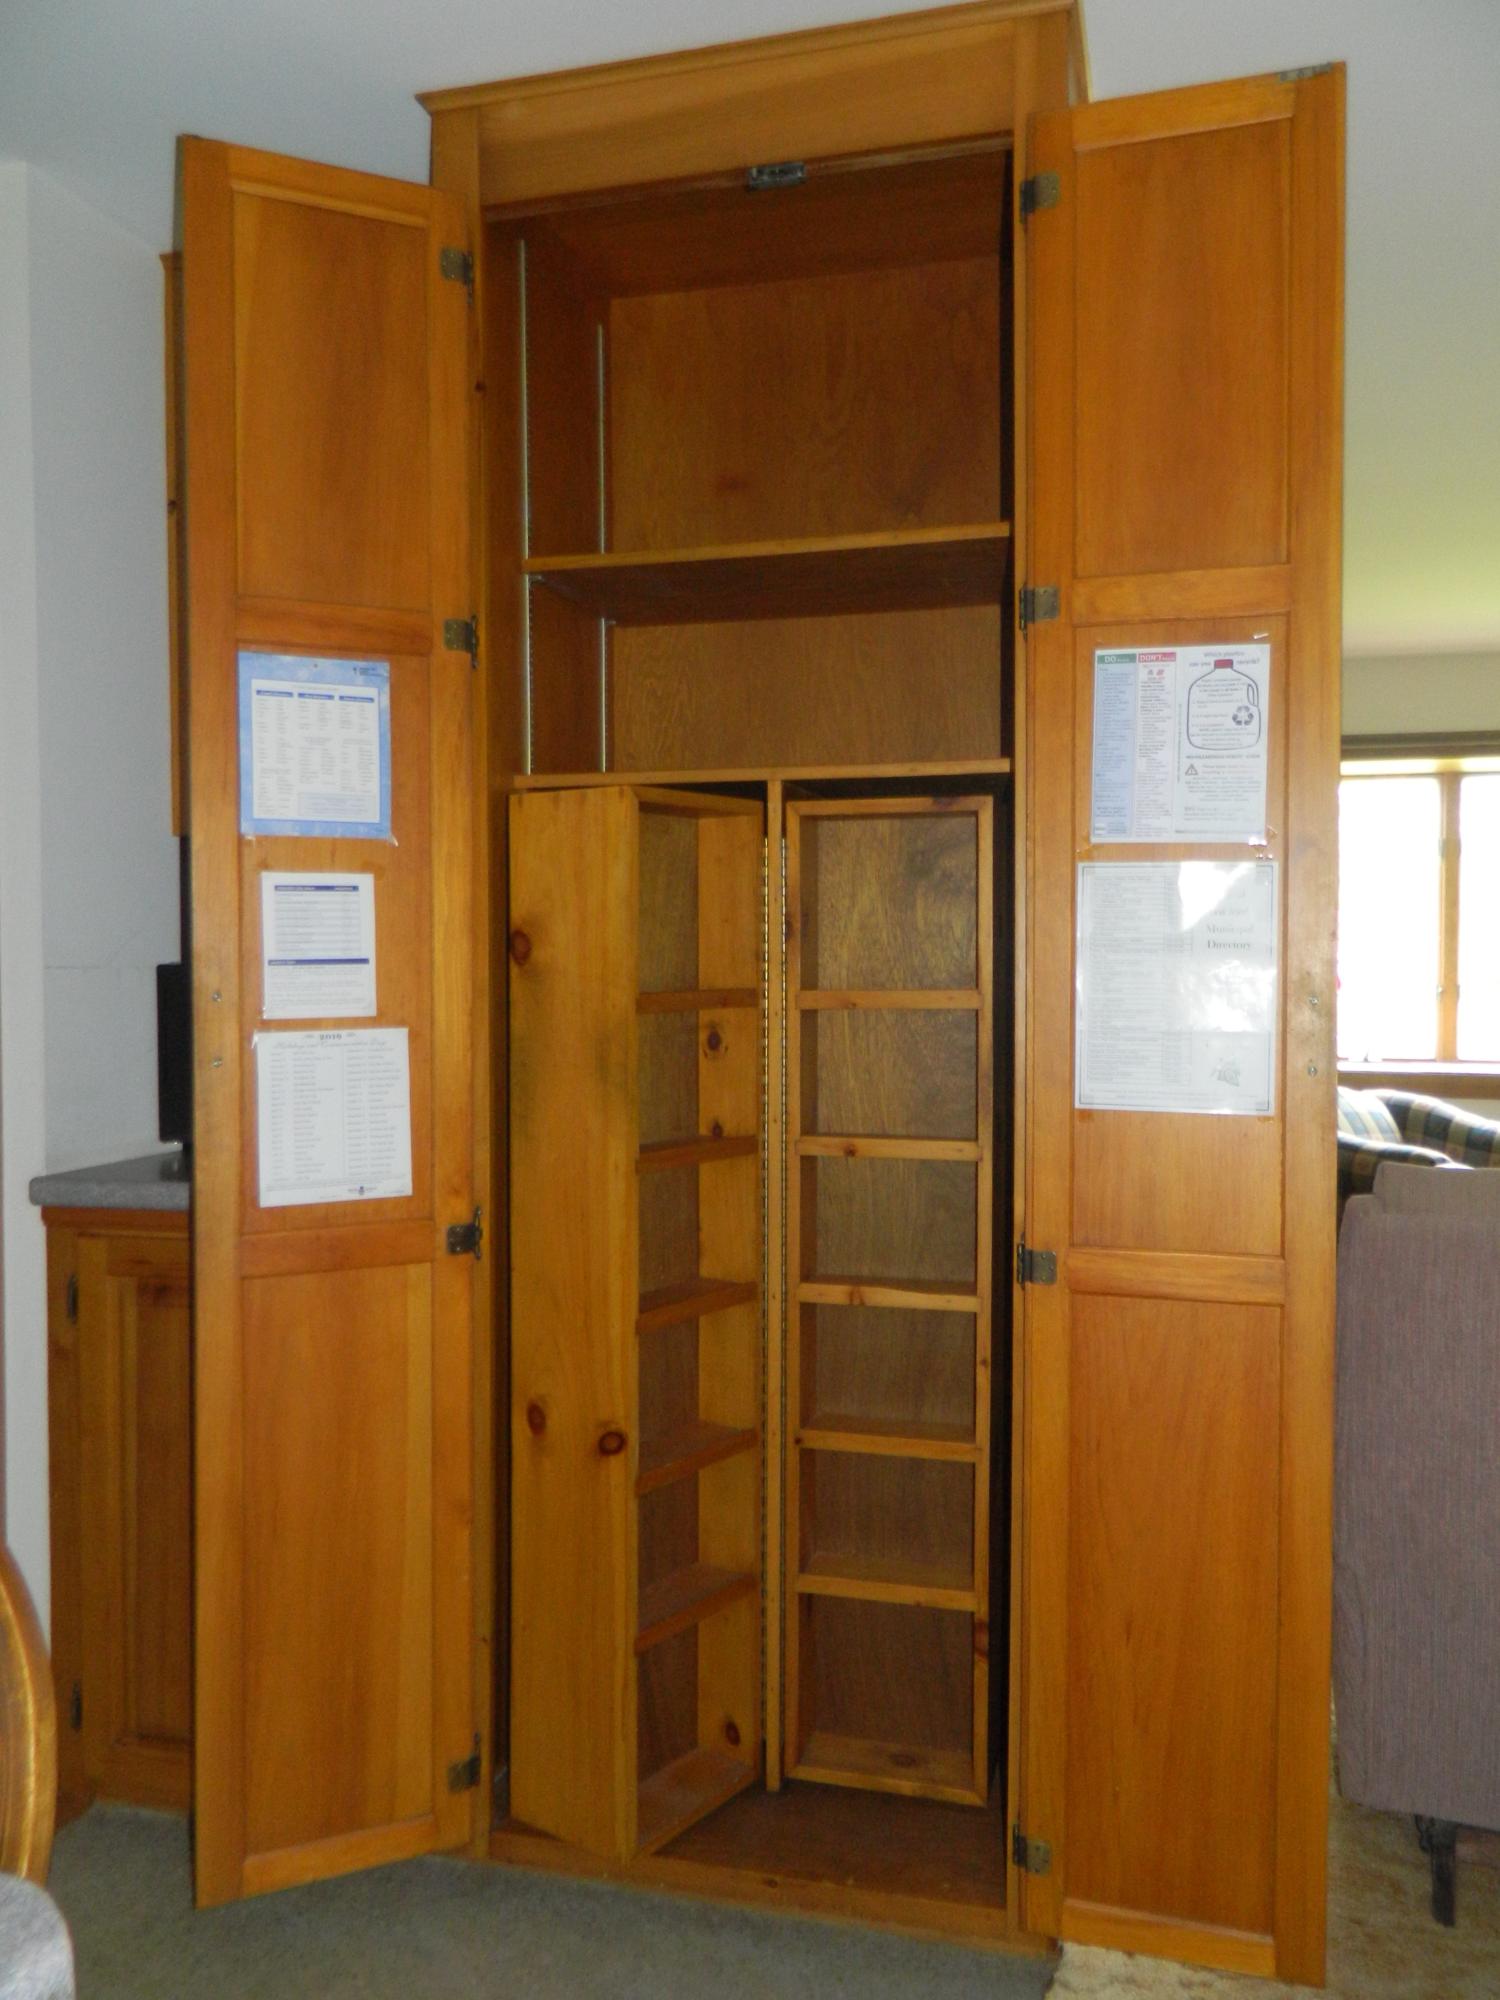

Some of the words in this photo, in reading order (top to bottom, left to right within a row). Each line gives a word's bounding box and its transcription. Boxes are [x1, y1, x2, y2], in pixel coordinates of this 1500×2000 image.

[1104, 655, 1117, 664] DO
[1140, 654, 1162, 663] DON'T
[1207, 939, 1251, 951] Directory
